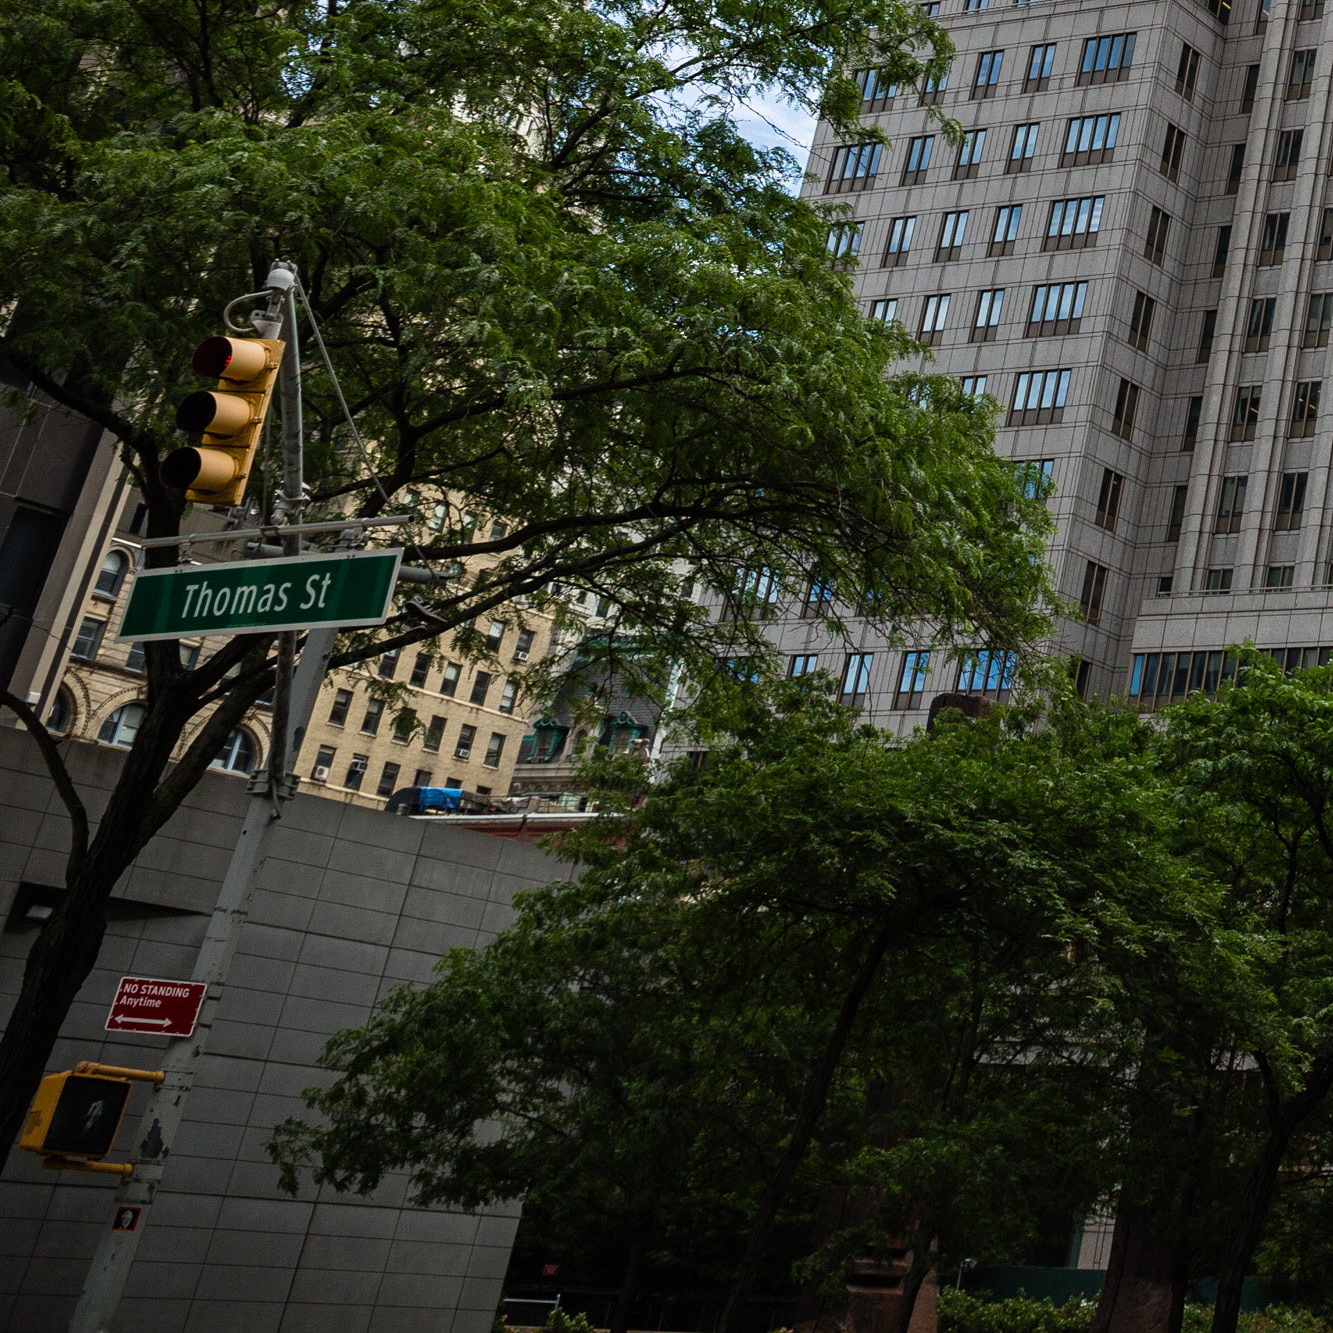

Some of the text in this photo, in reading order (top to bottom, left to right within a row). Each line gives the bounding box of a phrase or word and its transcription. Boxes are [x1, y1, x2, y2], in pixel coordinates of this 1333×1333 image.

[181, 572, 332, 619] Thomas St
[122, 984, 190, 998] NO STANDING
[119, 995, 162, 1008] Anytime
